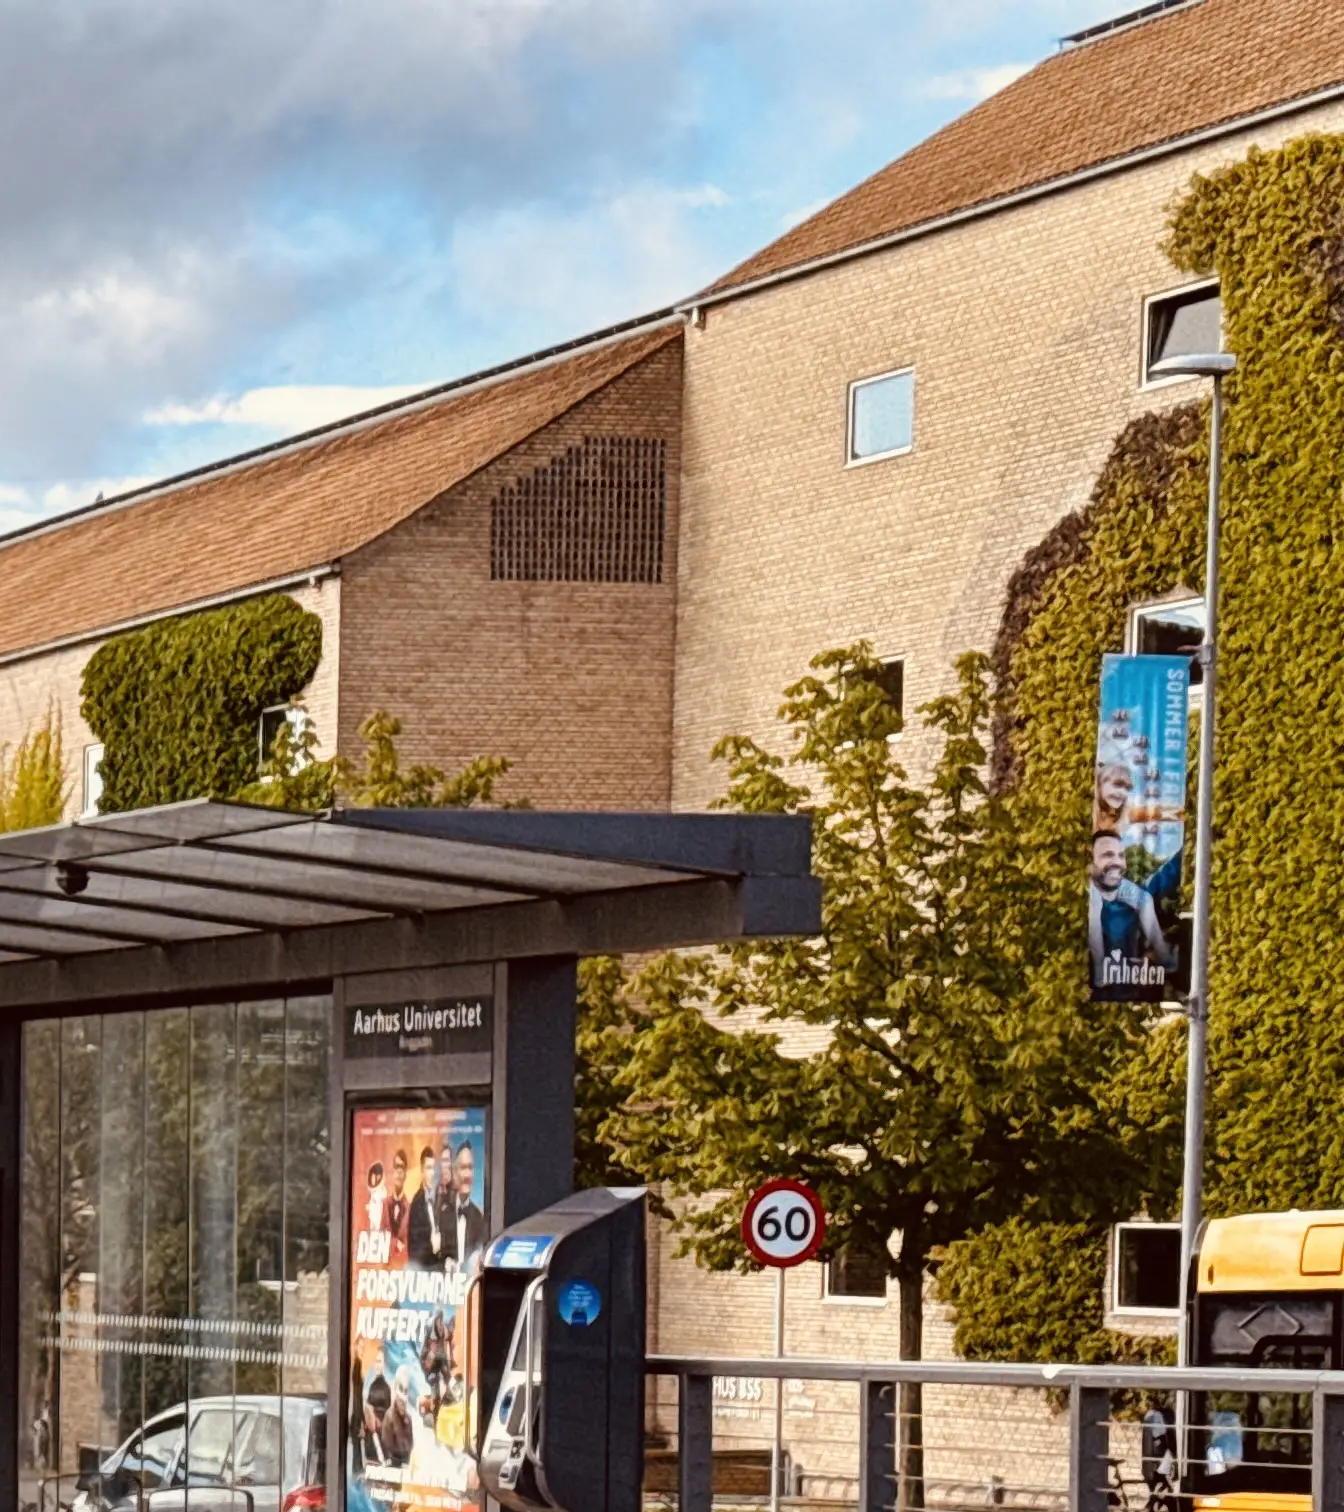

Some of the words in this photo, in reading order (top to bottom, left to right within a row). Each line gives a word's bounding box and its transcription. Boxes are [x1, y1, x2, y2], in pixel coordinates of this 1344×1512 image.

[1163, 669, 1185, 752] SOMMER
[354, 1008, 401, 1035] Aarhus
[404, 1002, 482, 1032] Universitet
[757, 1206, 810, 1241] 60
[356, 1230, 391, 1264] DEN
[356, 1268, 467, 1305] FORSVUNDNE
[356, 1307, 430, 1342] KUFFERT
